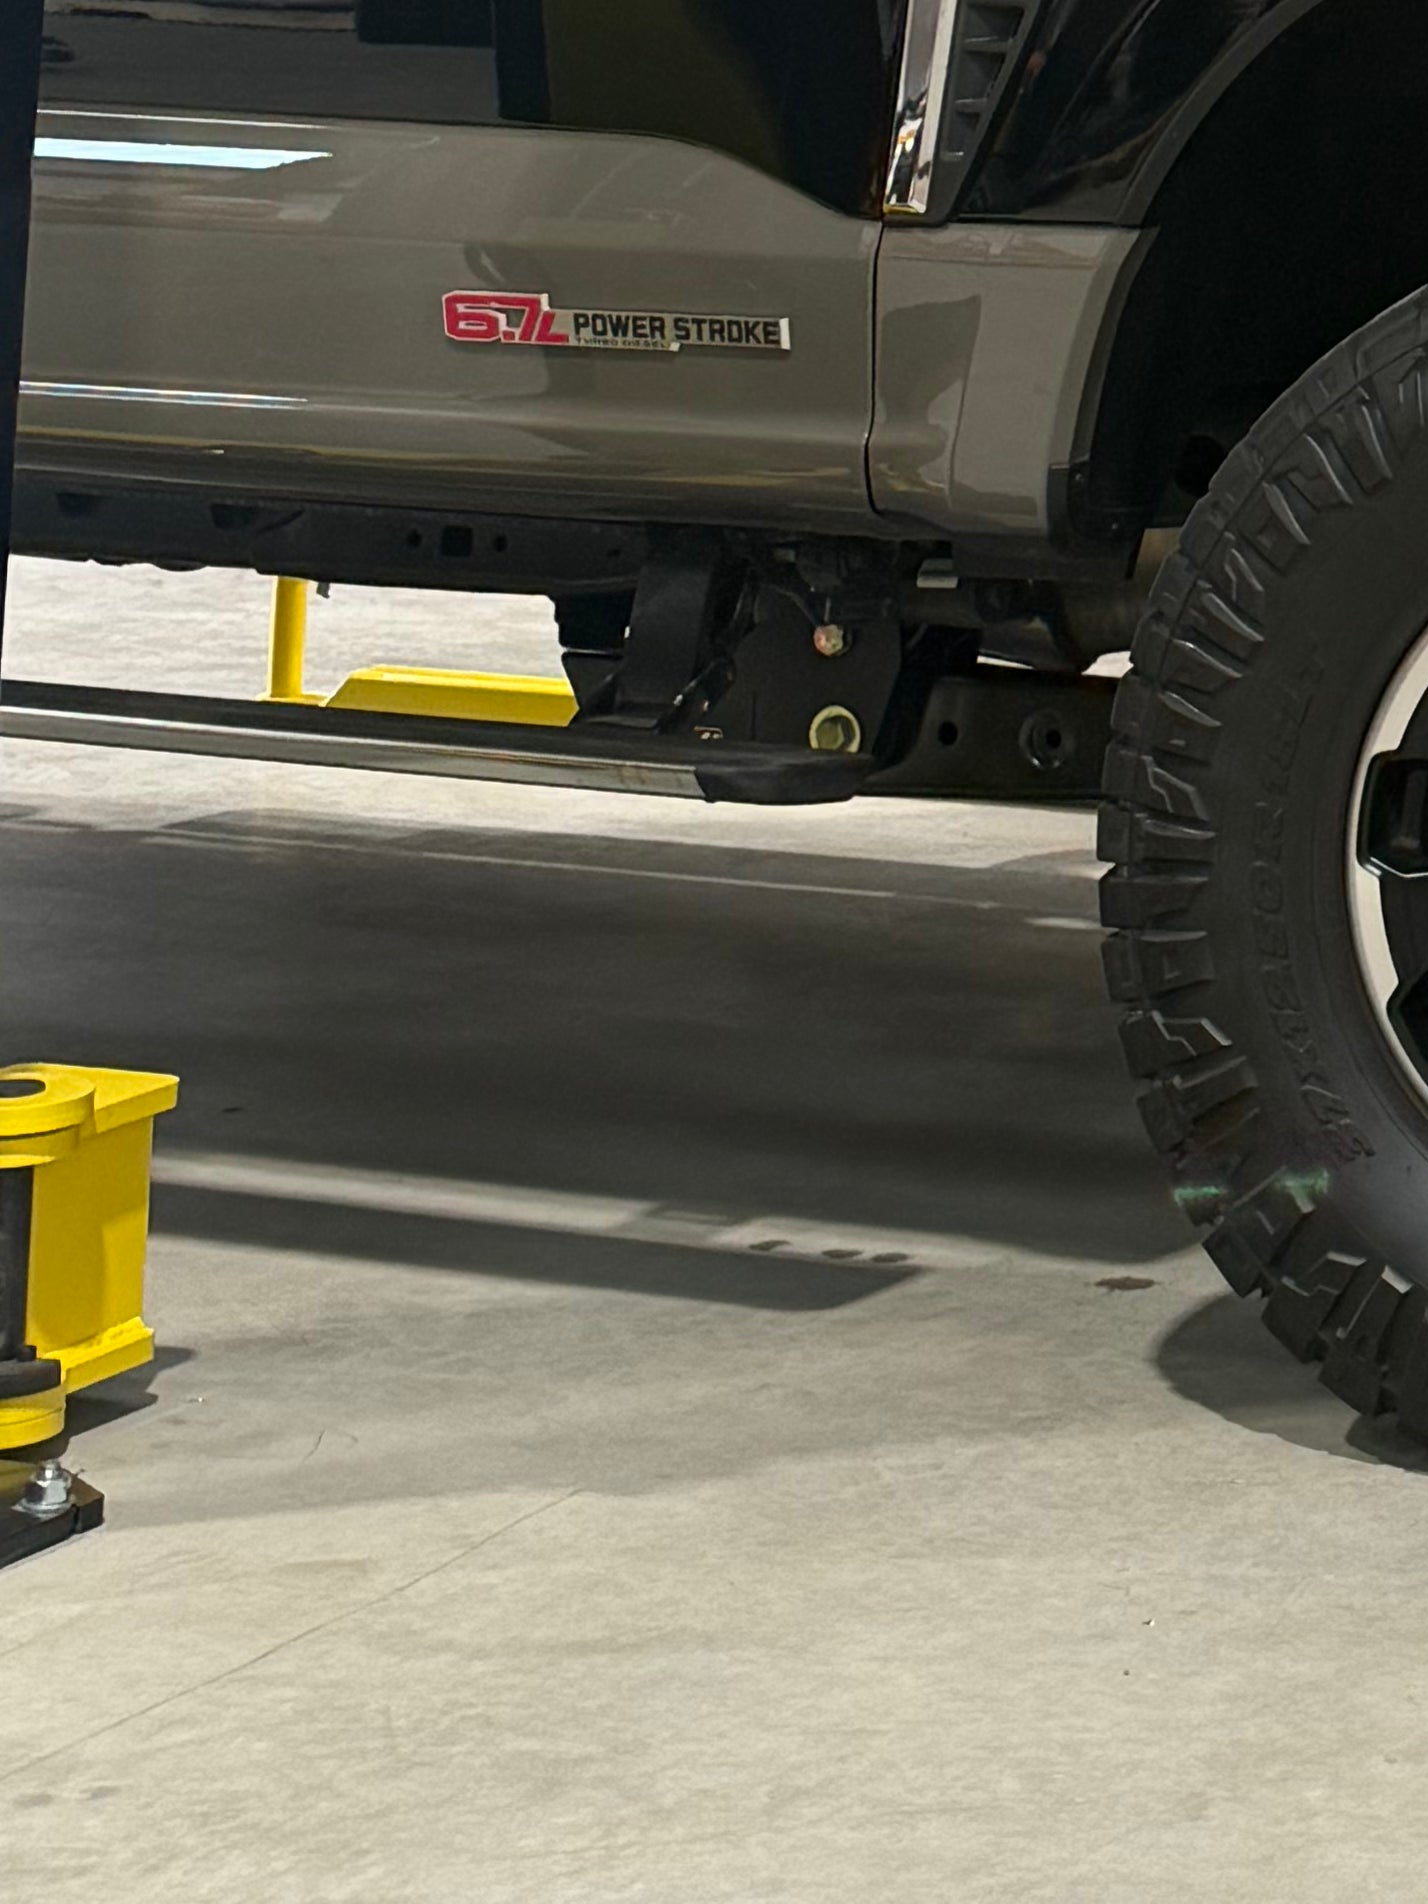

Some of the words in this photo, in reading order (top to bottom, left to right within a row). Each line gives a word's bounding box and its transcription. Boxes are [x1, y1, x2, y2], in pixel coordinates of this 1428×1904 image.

[443, 291, 570, 344] 6.7L
[573, 312, 665, 339] POWER
[673, 317, 780, 345] STROKE
